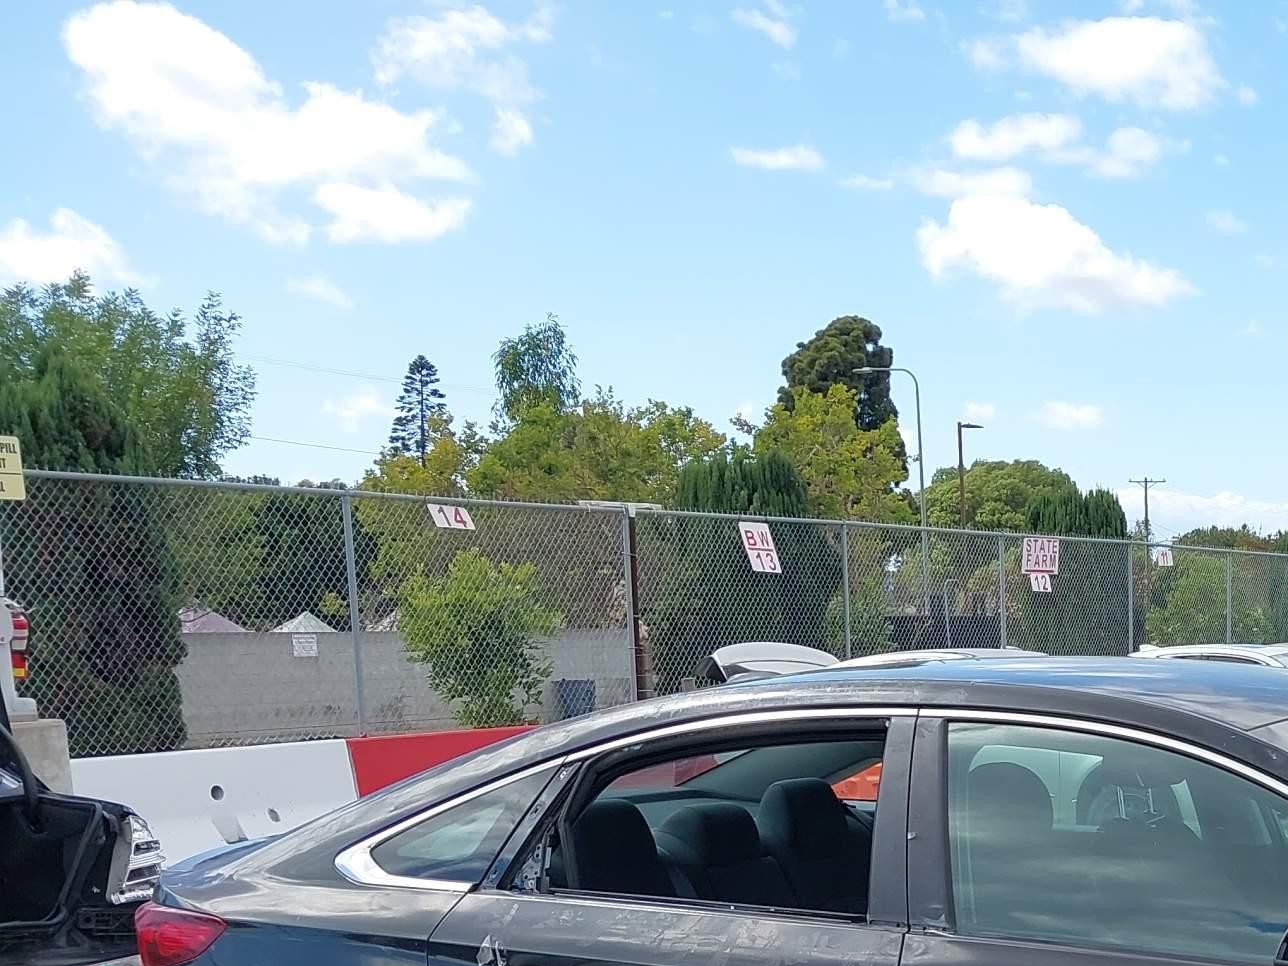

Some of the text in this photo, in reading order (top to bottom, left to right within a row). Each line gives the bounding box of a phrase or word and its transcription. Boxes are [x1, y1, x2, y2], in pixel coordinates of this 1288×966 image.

[437, 506, 468, 528] 14
[744, 529, 770, 547] BW
[1025, 539, 1058, 554] STATE
[755, 551, 777, 571] 13
[1026, 553, 1057, 569] FARM
[1034, 575, 1049, 591] 12
